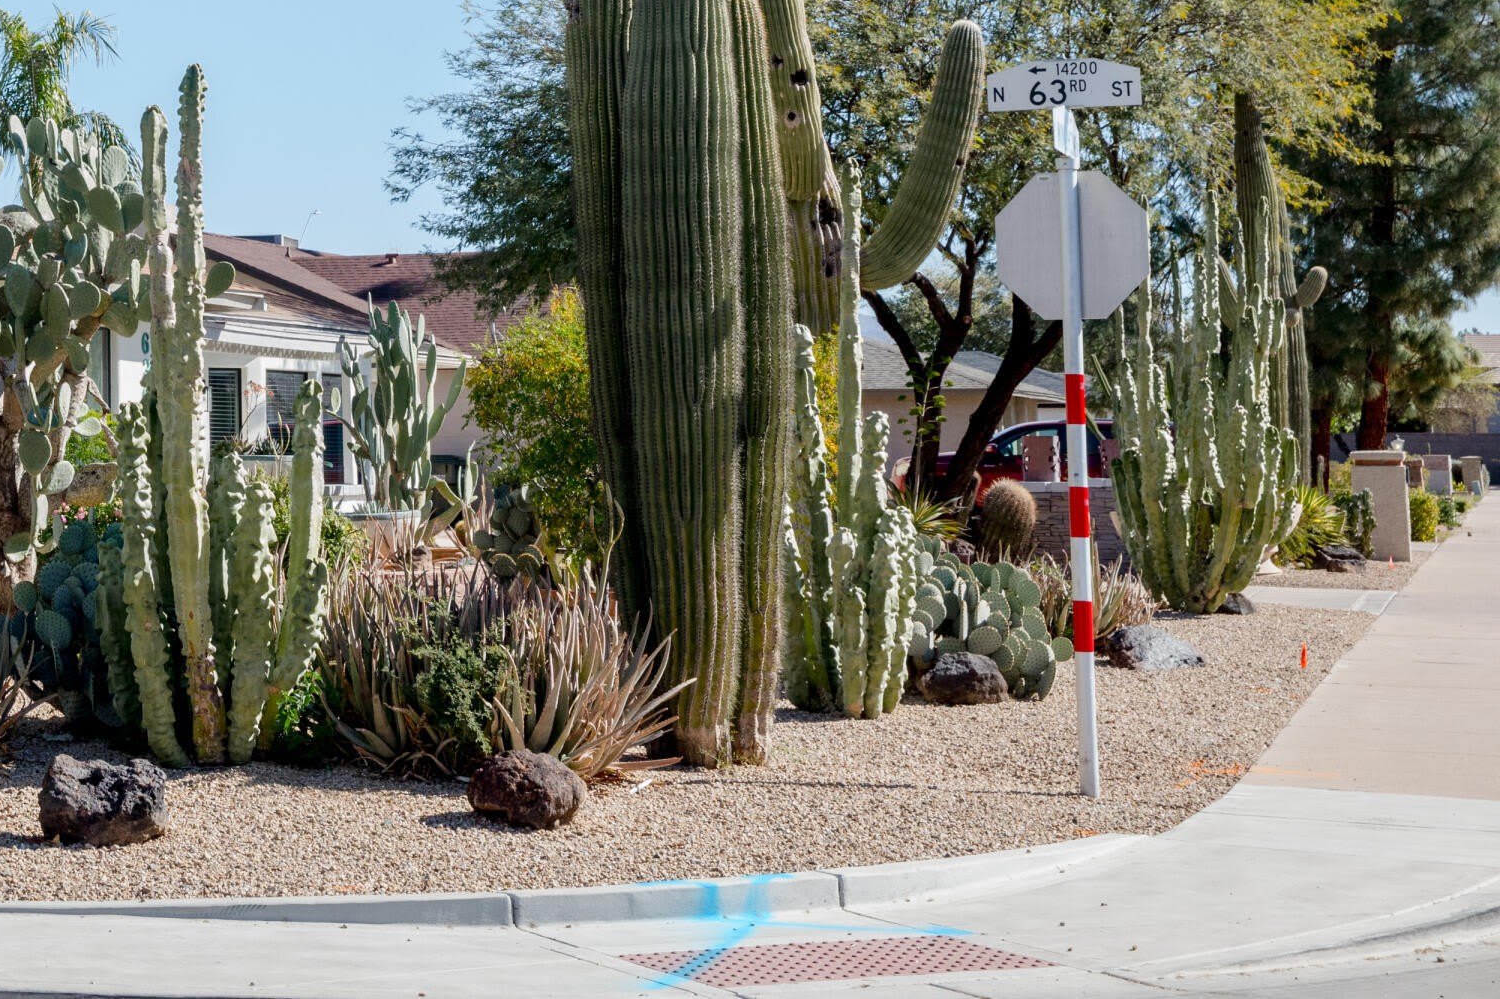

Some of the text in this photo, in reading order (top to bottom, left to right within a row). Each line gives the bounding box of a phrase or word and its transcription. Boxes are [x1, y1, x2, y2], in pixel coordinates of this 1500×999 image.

[1055, 61, 1098, 76] 14200
[993, 86, 1005, 103] N
[1111, 80, 1133, 97] ST
